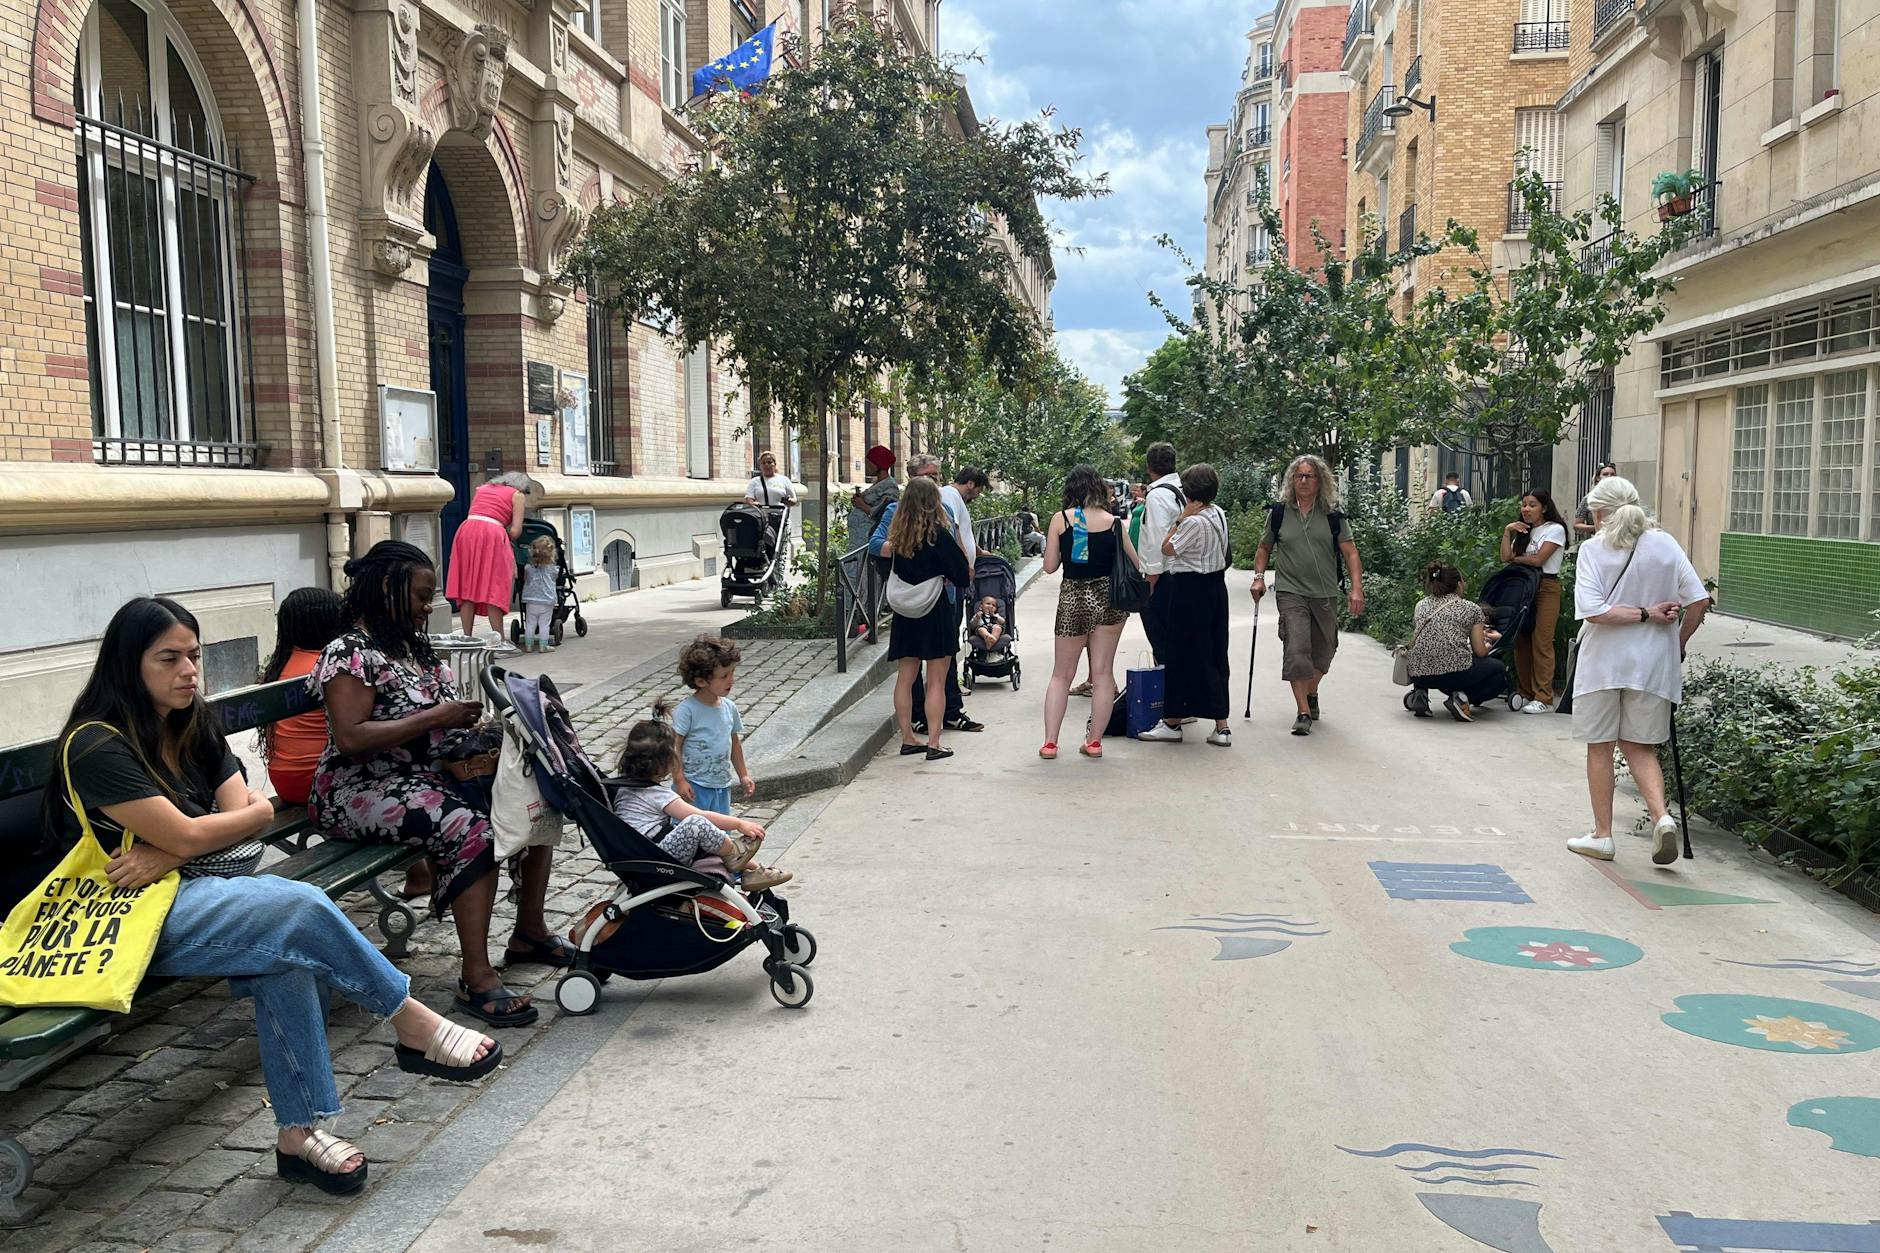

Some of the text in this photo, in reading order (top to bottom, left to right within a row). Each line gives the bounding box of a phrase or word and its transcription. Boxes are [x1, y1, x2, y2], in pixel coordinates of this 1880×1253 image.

[655, 866, 675, 875] YOYO
[44, 878, 71, 898] ET
[18, 917, 121, 953] PUR LA
[97, 948, 114, 974] ?
